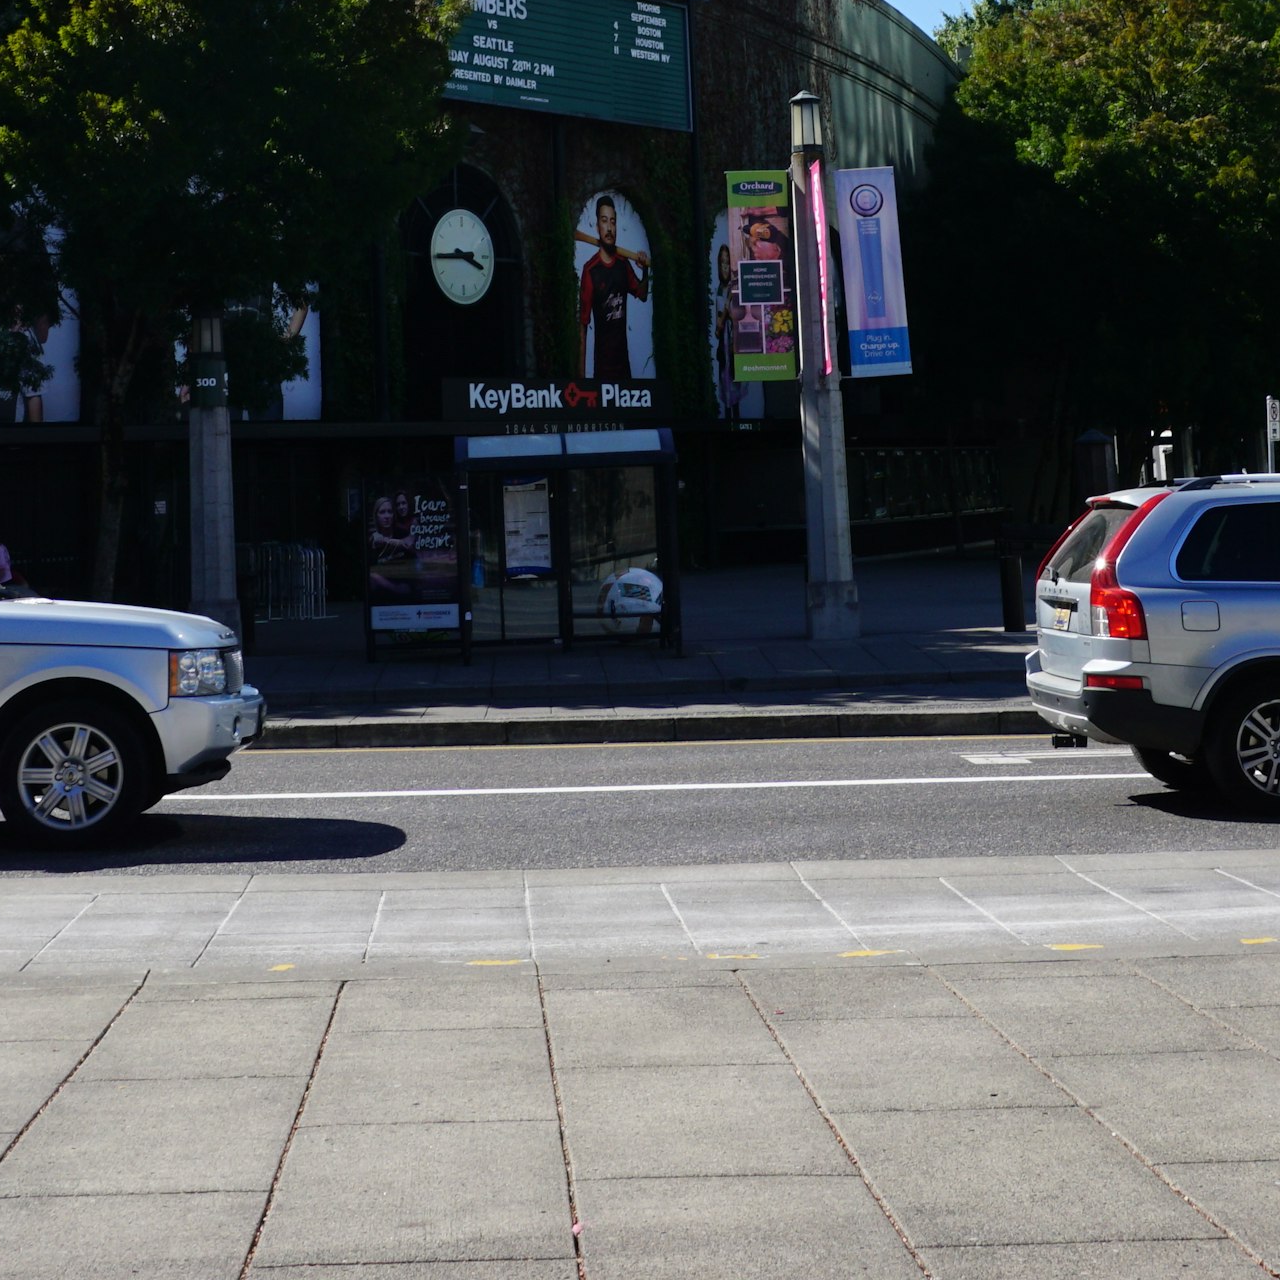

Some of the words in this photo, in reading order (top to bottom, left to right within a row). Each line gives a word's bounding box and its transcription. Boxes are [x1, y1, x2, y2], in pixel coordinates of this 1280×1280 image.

[637, 2, 661, 14] THORNS
[487, 19, 498, 30] VS
[631, 13, 666, 27] SEPTEMBER
[637, 26, 662, 38] BOSTON
[473, 35, 514, 53] SEATTLE
[614, 34, 619, 42] 7
[635, 38, 664, 50] HOUSTON
[631, 49, 660, 61] WESTERN
[661, 54, 671, 63] NY
[473, 53, 509, 70] AUGUST
[512, 59, 531, 72] 28TH
[534, 63, 540, 75] 2
[541, 64, 555, 77] PM
[494, 75, 503, 84] BY
[506, 77, 537, 90] DAIMLER
[740, 182, 774, 191] Orchard
[860, 343, 887, 351] Charge
[469, 383, 563, 414] KeyBank
[601, 384, 652, 408] Plaza
[505, 424, 535, 435] 1844
[544, 424, 558, 435] SW
[568, 423, 625, 434] MORRISON
[421, 499, 447, 512] care
[420, 513, 450, 524] because
[410, 524, 445, 536] cancer
